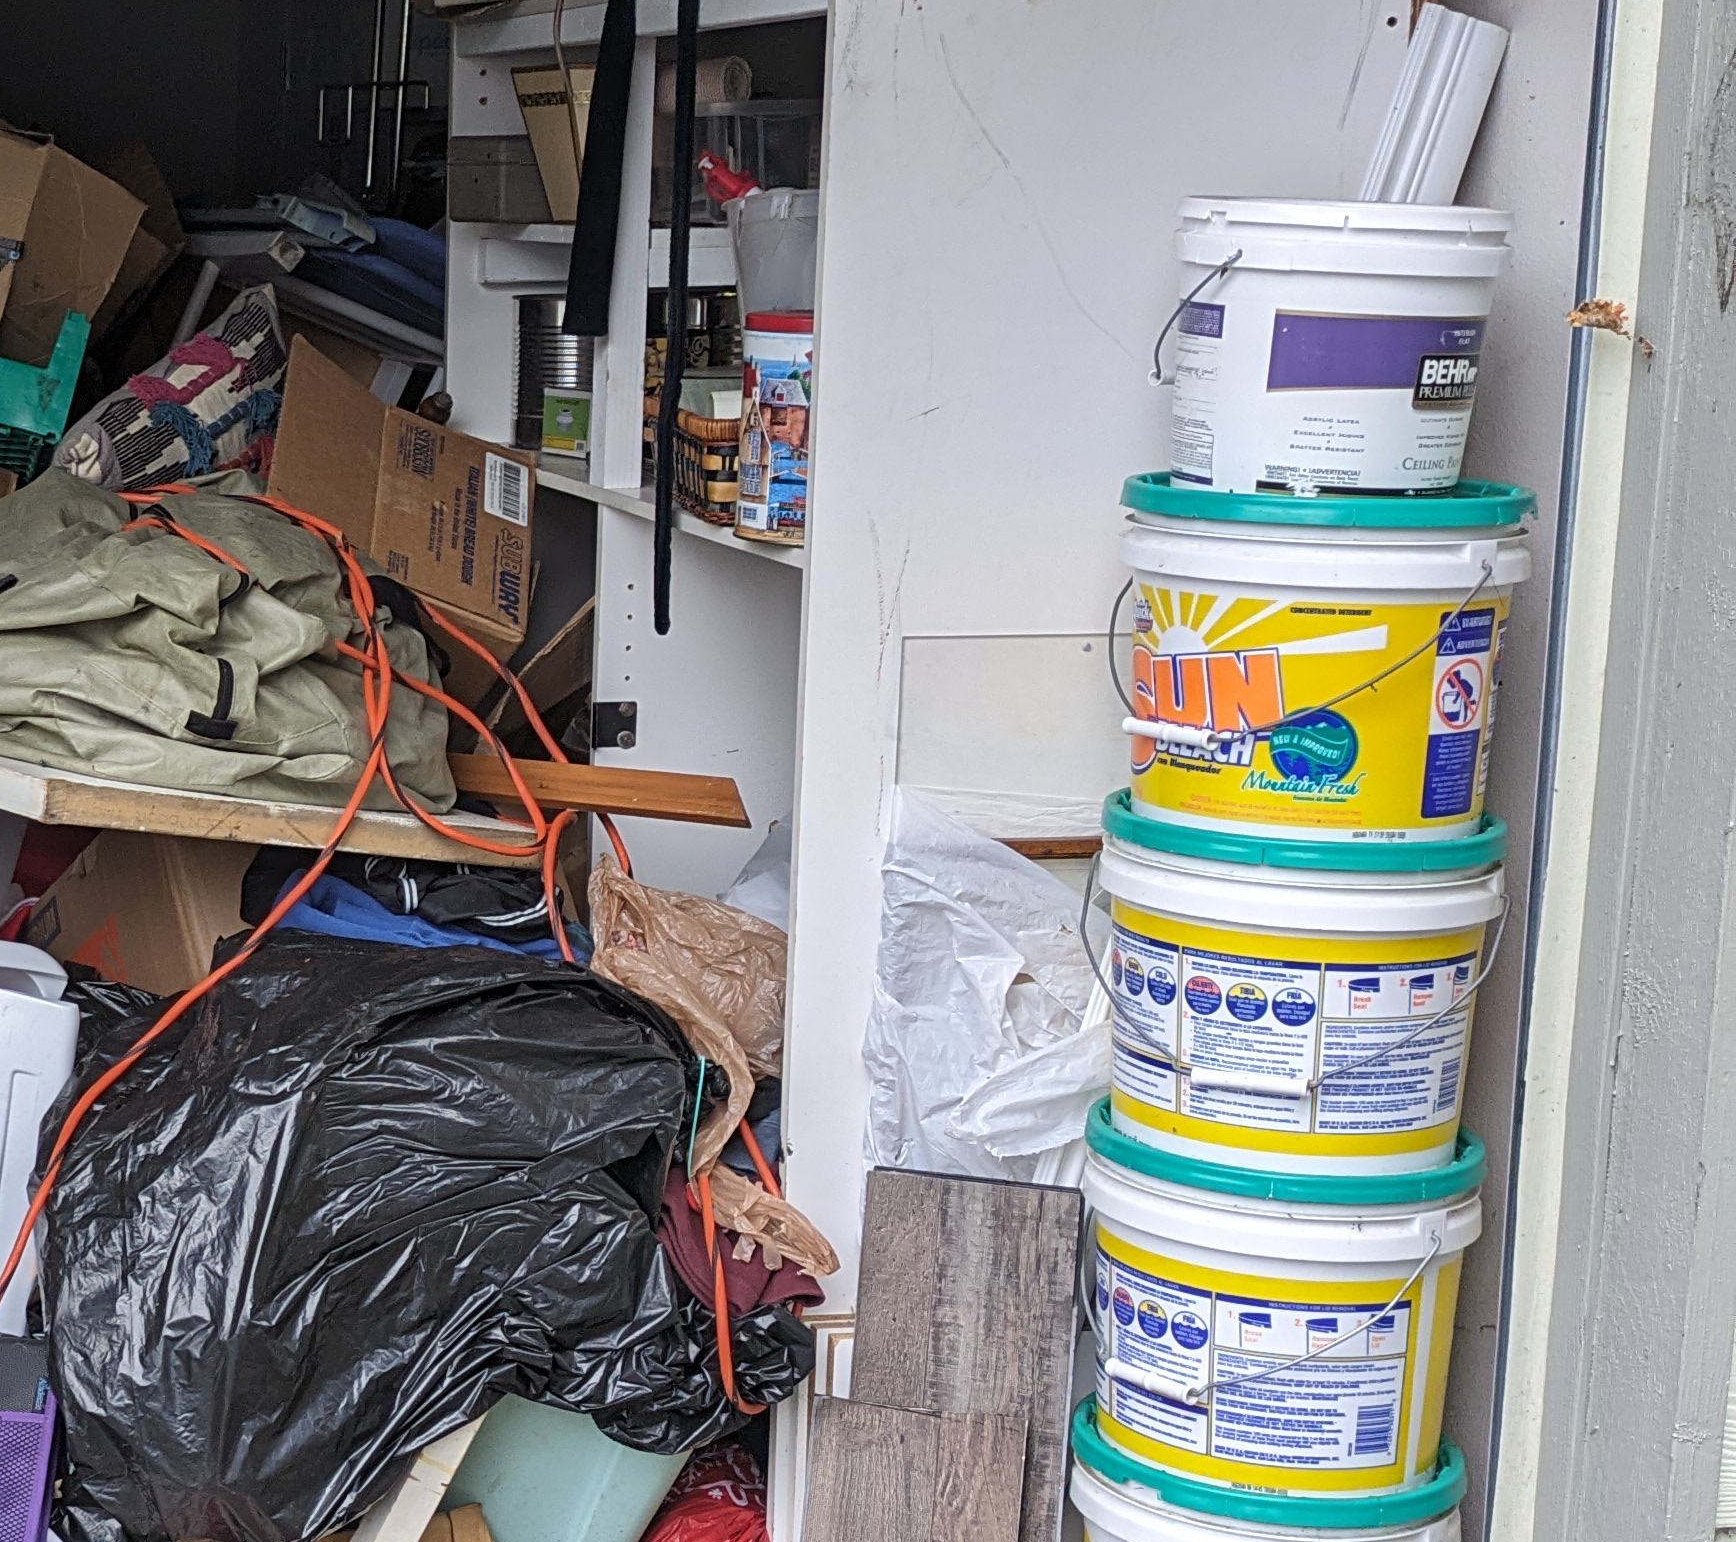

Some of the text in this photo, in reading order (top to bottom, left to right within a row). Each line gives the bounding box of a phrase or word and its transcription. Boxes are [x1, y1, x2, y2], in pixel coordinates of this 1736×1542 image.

[1421, 358, 1469, 385] BEHR
[1418, 385, 1463, 399] PREMIUM
[1401, 456, 1445, 471] CEILING
[466, 465, 481, 497] ITALIAN
[462, 525, 477, 556] BREAD
[497, 528, 525, 624] SUBWAY
[1132, 644, 1284, 775] SUN
[1273, 734, 1291, 747] NEW
[1300, 736, 1341, 760] IMPROVED!
[1240, 769, 1367, 797] Mountain Fresh
[1268, 1302, 1309, 1311] INSTRUCTIONS
